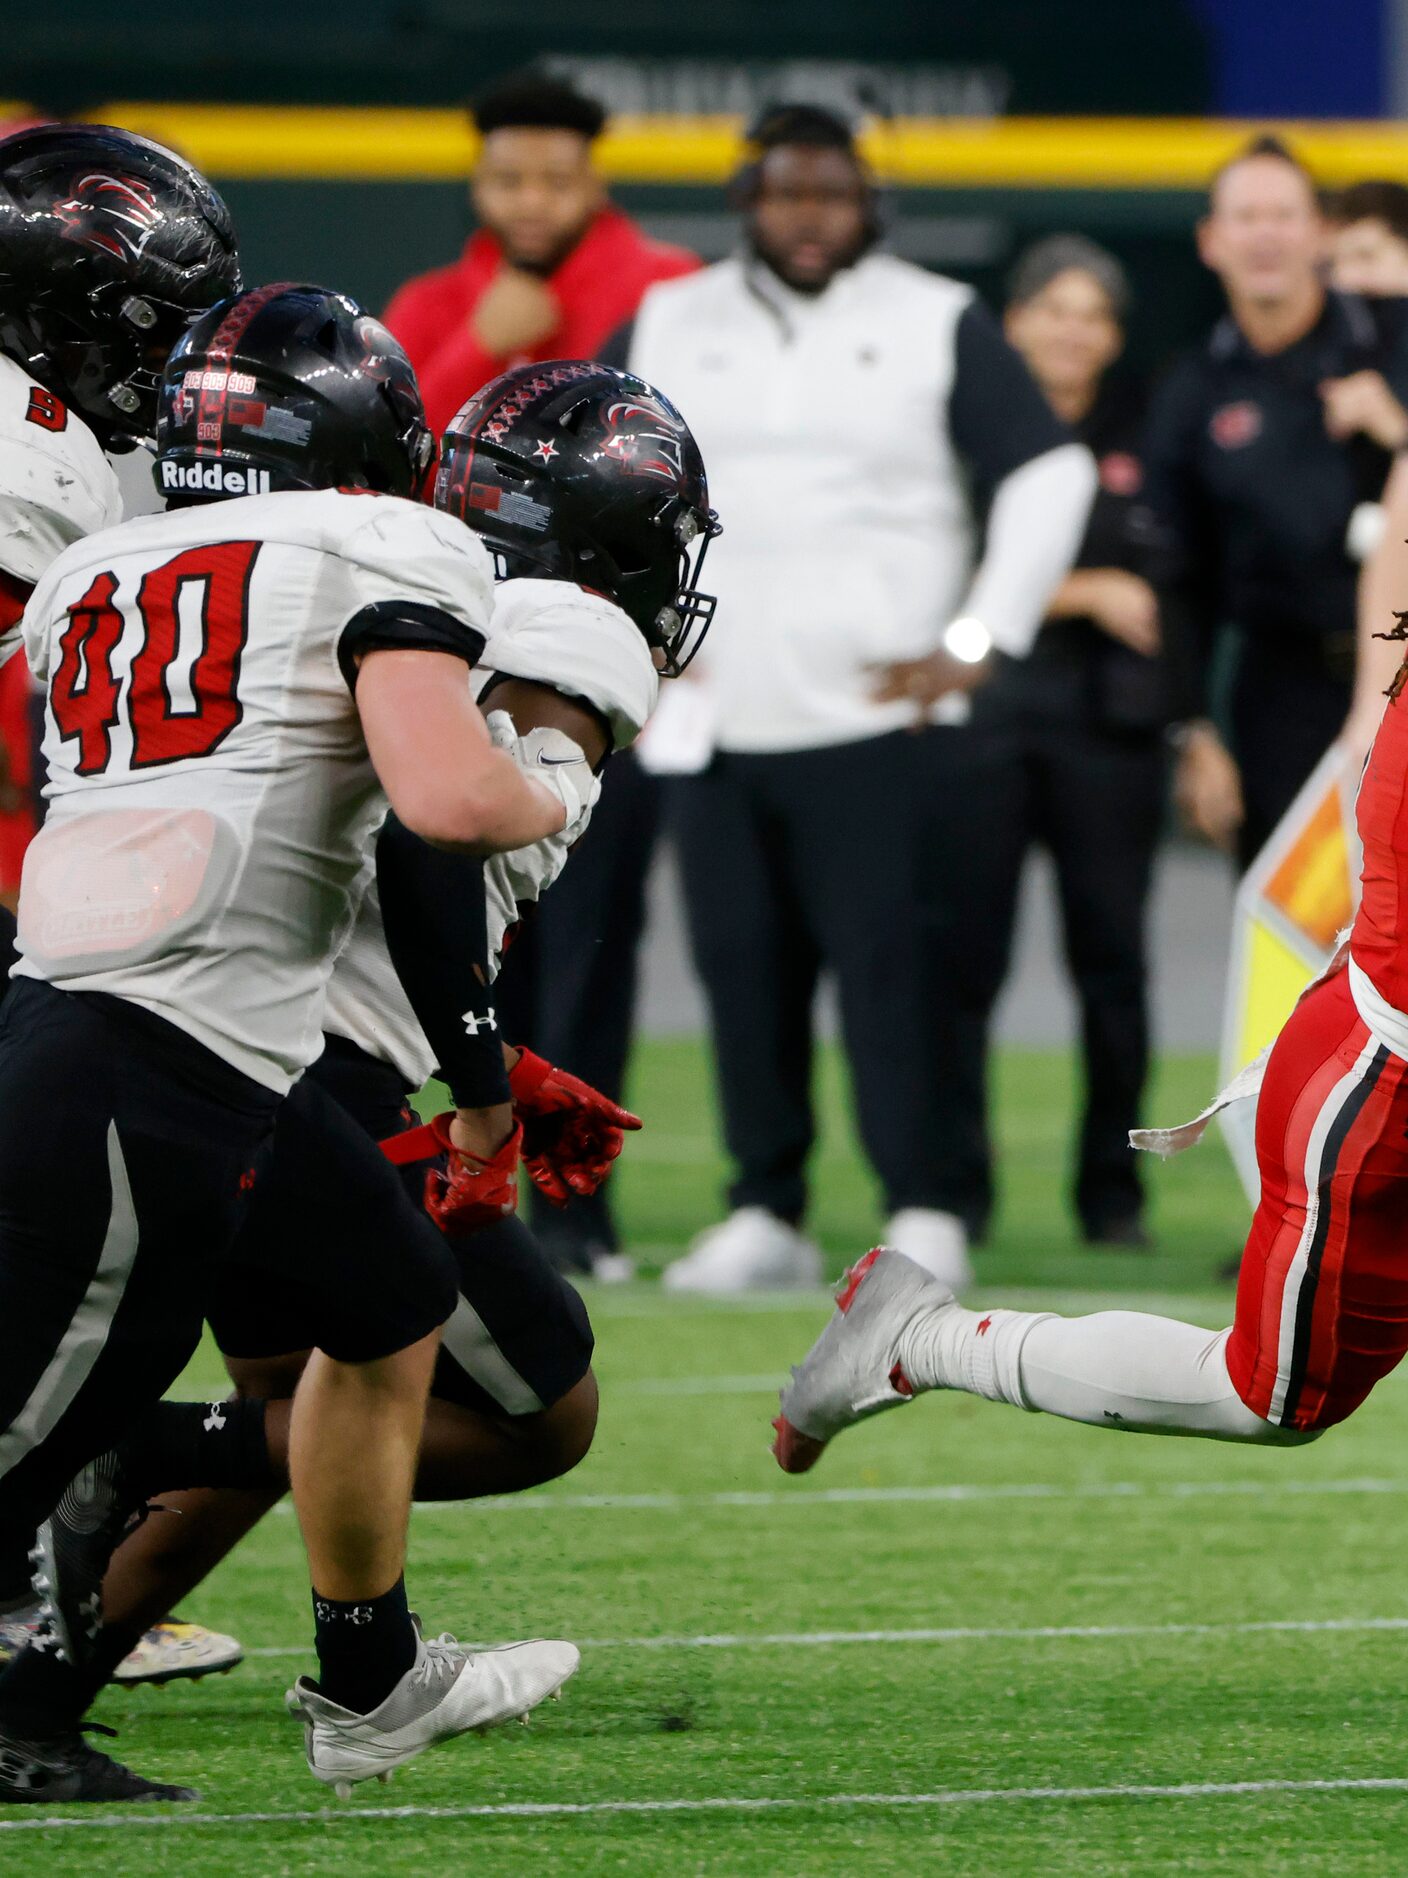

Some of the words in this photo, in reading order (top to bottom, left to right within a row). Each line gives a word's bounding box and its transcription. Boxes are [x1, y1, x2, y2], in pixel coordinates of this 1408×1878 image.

[203, 372, 227, 390] 903
[228, 375, 256, 394] 903
[198, 424, 221, 440] 903
[162, 461, 270, 494] Riddell
[50, 539, 265, 777] 40
